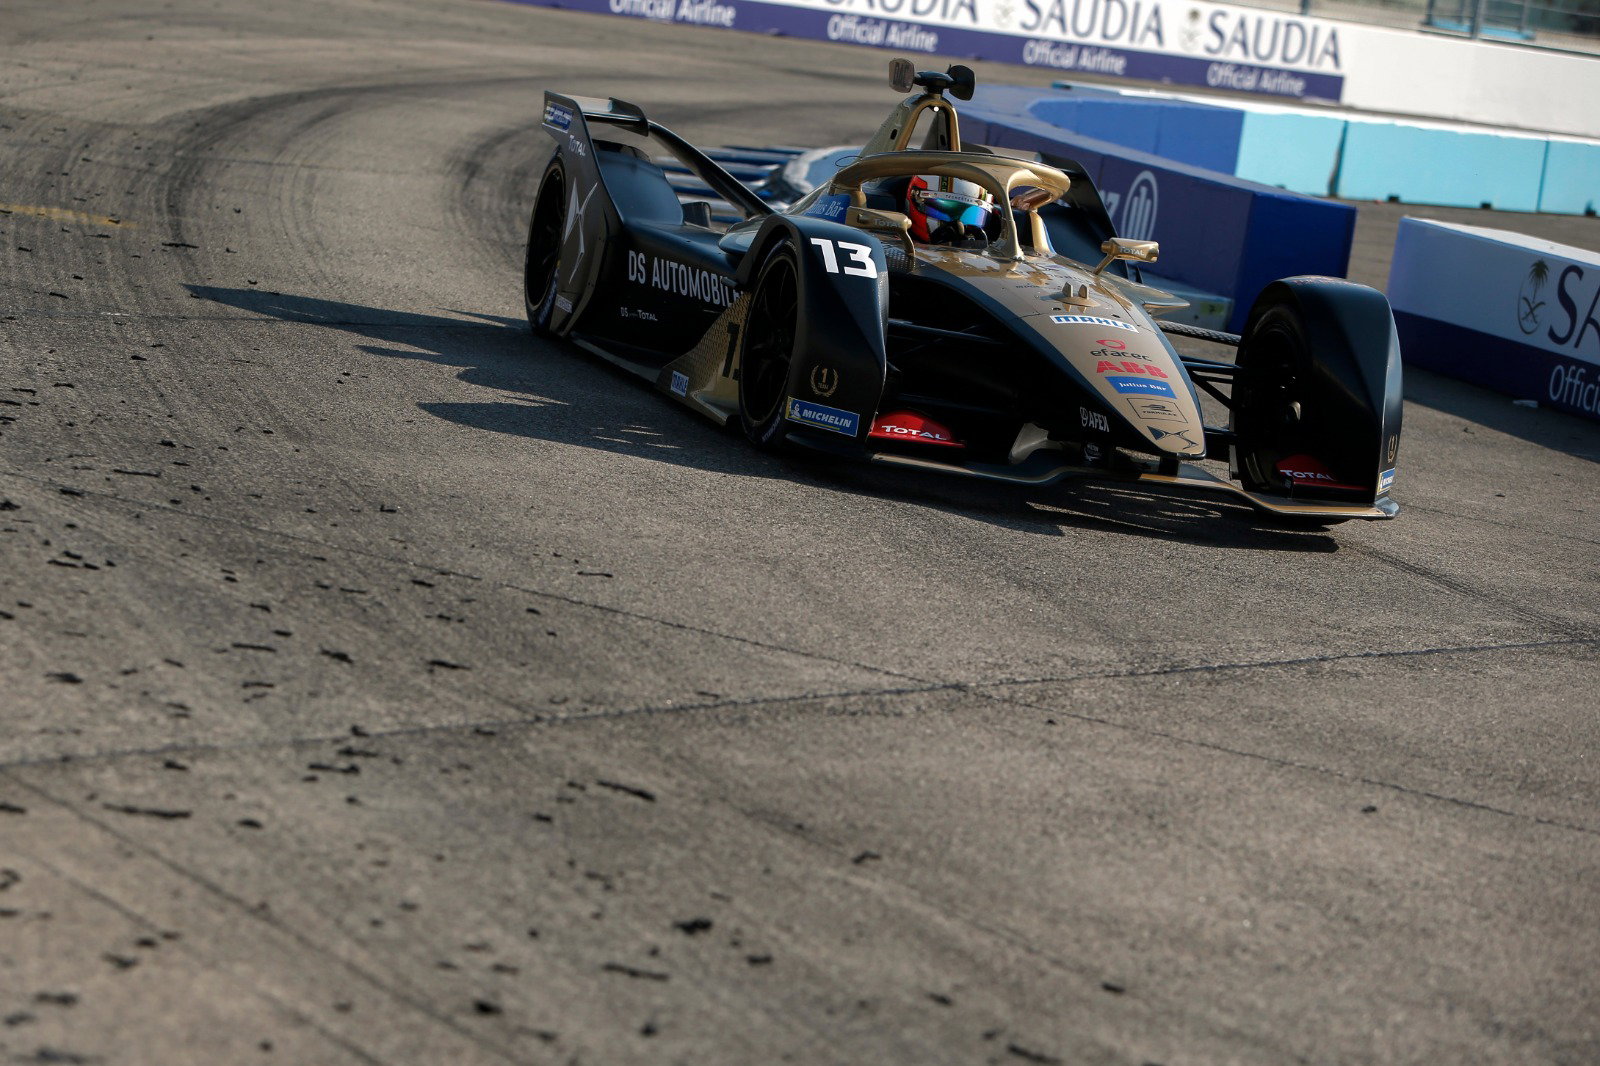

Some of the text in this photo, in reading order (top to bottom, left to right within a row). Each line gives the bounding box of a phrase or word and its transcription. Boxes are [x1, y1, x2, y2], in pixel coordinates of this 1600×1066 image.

[827, 13, 939, 52] Official Airline
[1020, 0, 1164, 47] SAUDIA
[1204, 9, 1342, 69] SAUDIA
[1022, 39, 1127, 75] Official Airline
[1206, 62, 1306, 97] Official Airline
[810, 238, 877, 279] 13
[628, 250, 745, 308] DS AUTOMOBIL
[1054, 315, 1135, 331] MAHLE
[1090, 348, 1152, 362] efacec
[1096, 360, 1169, 379] ABB
[821, 367, 828, 383] 1
[1550, 364, 1600, 415] Offici
[802, 408, 852, 428] MICHELIN
[881, 425, 948, 441] TOTAL
[1279, 469, 1337, 482] TOTAL
